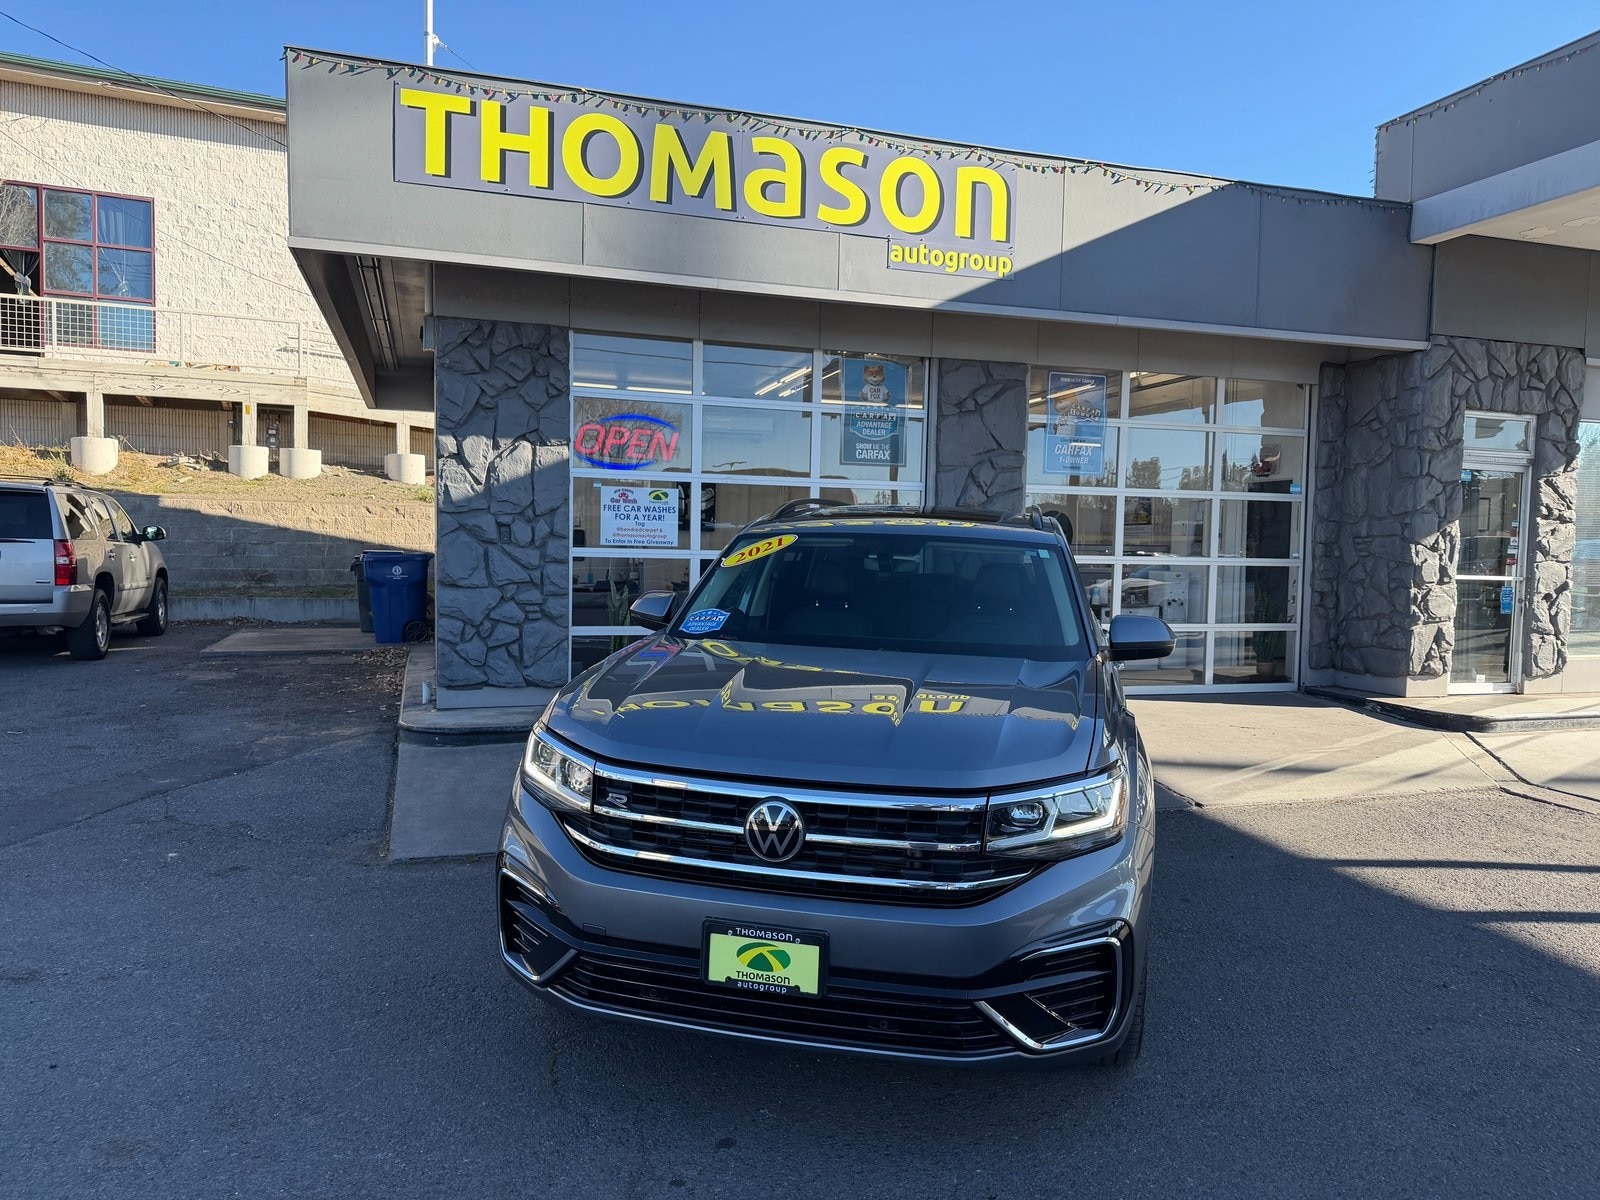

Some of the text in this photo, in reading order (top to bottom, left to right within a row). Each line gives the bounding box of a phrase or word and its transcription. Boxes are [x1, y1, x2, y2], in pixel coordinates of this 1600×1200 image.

[889, 243, 1014, 277] autogroup
[855, 412, 896, 421] CARFAX
[856, 421, 892, 429] ADVANTAGE
[862, 428, 886, 436] DEALER
[574, 422, 680, 463] OPEN
[855, 442, 872, 450] SHOW
[855, 449, 890, 460] CARFAX
[1054, 444, 1094, 456] CARFAX
[1059, 456, 1089, 465] 1-OWNER
[603, 504, 677, 514] FREE CAR WASHES
[642, 514, 665, 522] YEAR!
[735, 537, 783, 564] 2021
[737, 980, 787, 994] autogroup
